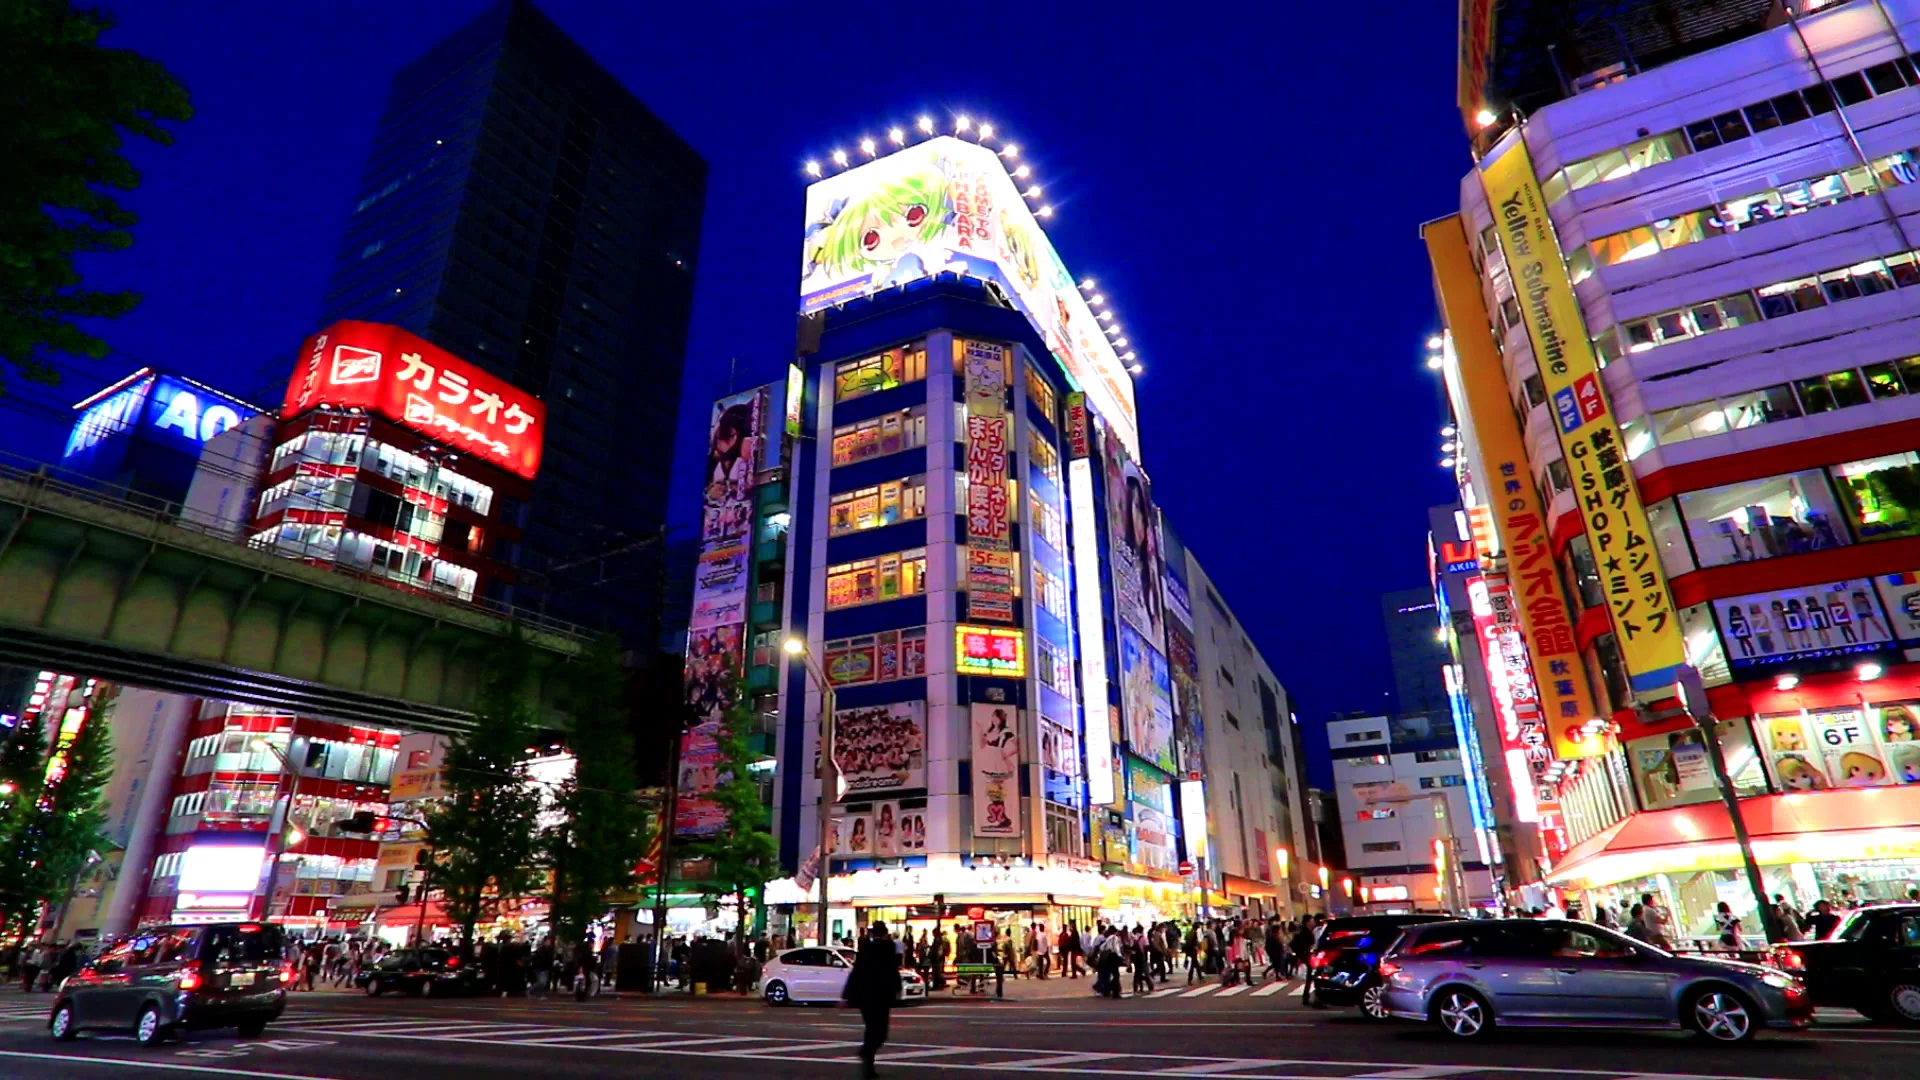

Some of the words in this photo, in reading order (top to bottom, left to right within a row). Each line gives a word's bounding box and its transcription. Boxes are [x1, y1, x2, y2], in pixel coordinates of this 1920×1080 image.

[1534, 216, 1547, 241] BASE
[1501, 190, 1533, 257] Yellow
[1521, 260, 1569, 375] Submarine
[297, 334, 329, 408] カラオケ
[395, 352, 535, 435] カラオケ
[1580, 380, 1599, 416] 4F
[155, 390, 239, 442] AO
[1556, 394, 1575, 429] 5F
[968, 416, 990, 536] まんが喫茶
[988, 418, 1008, 538] インターネット
[1589, 427, 1670, 634] 秋葉原ゲームショップ
[1507, 512, 1576, 658] ラジオ会館
[1731, 605, 1850, 638] azone
[1823, 725, 1860, 746] 6F
